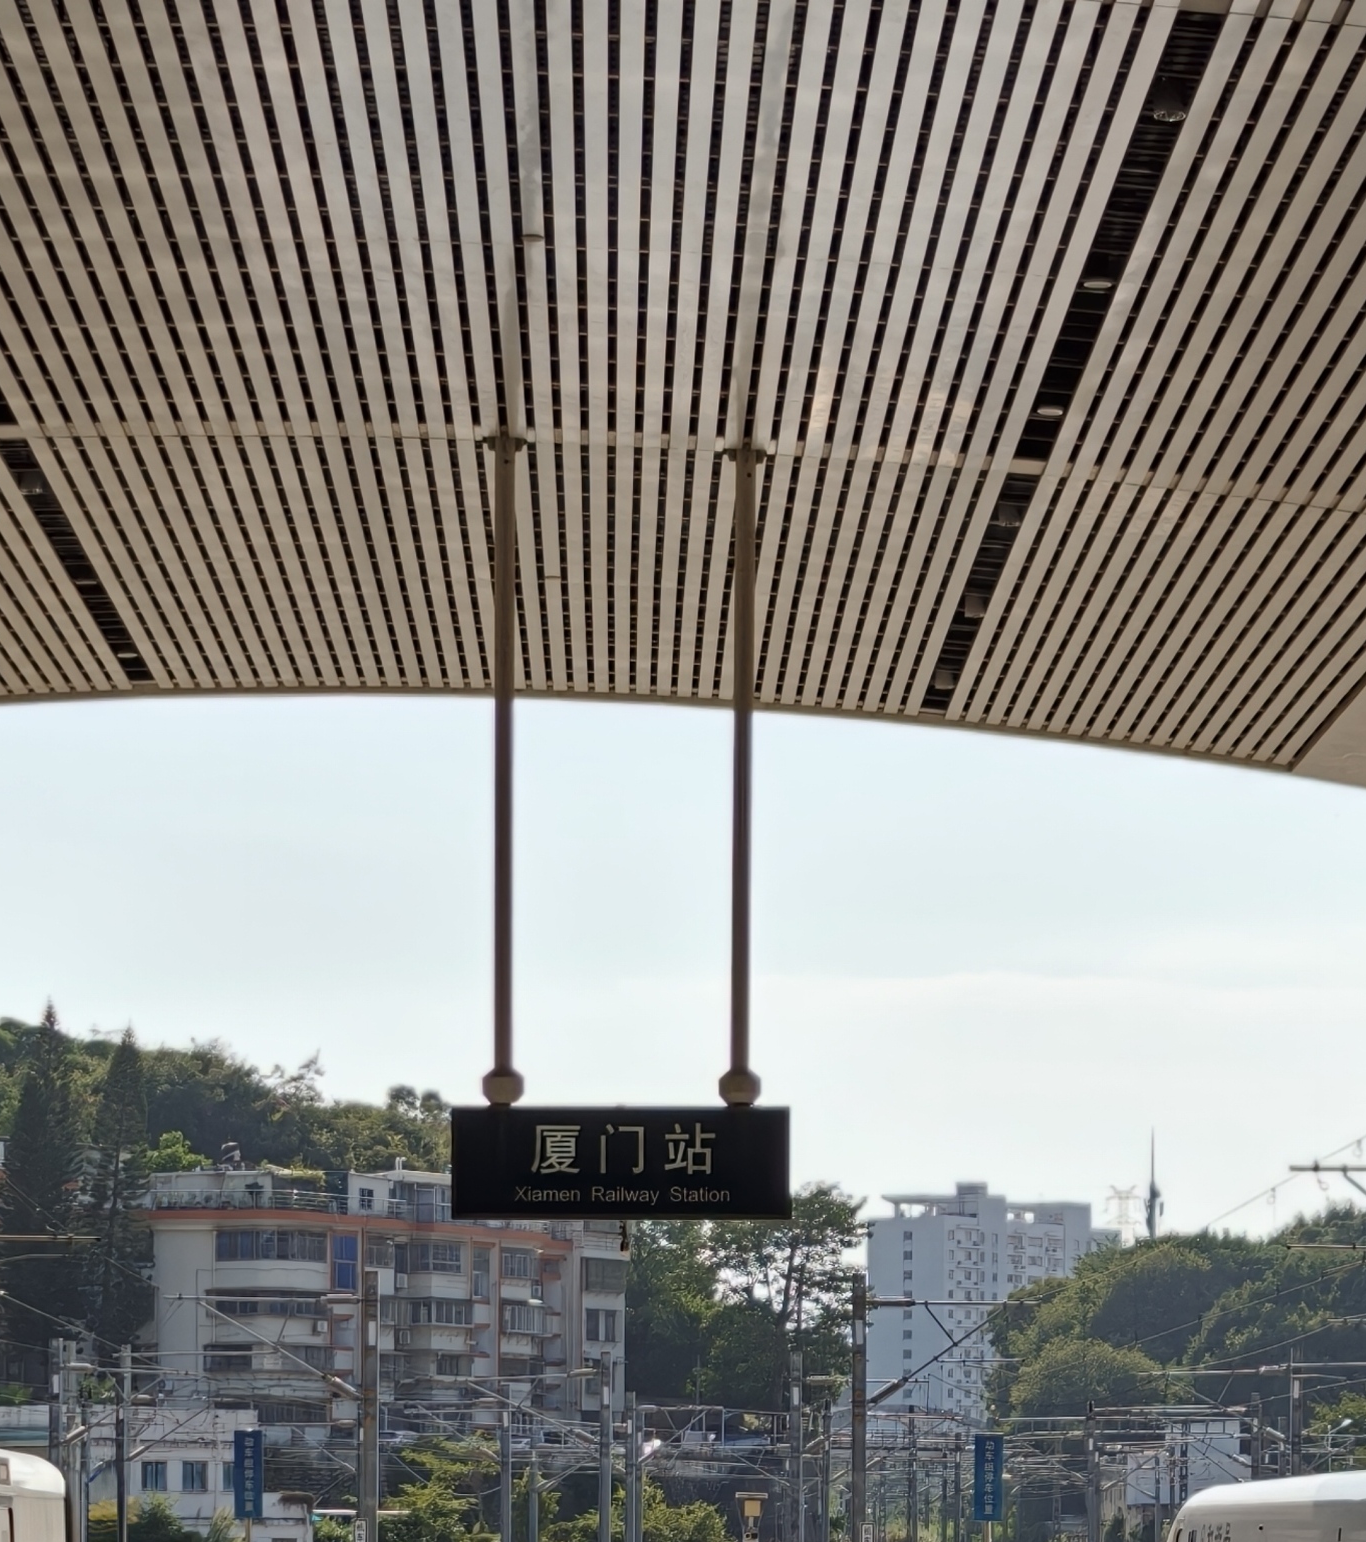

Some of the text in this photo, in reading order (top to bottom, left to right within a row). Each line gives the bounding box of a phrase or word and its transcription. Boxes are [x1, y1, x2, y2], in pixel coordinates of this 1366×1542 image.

[530, 1122, 717, 1175] 厦门站
[514, 1186, 731, 1206] Xiamen Railway Station
